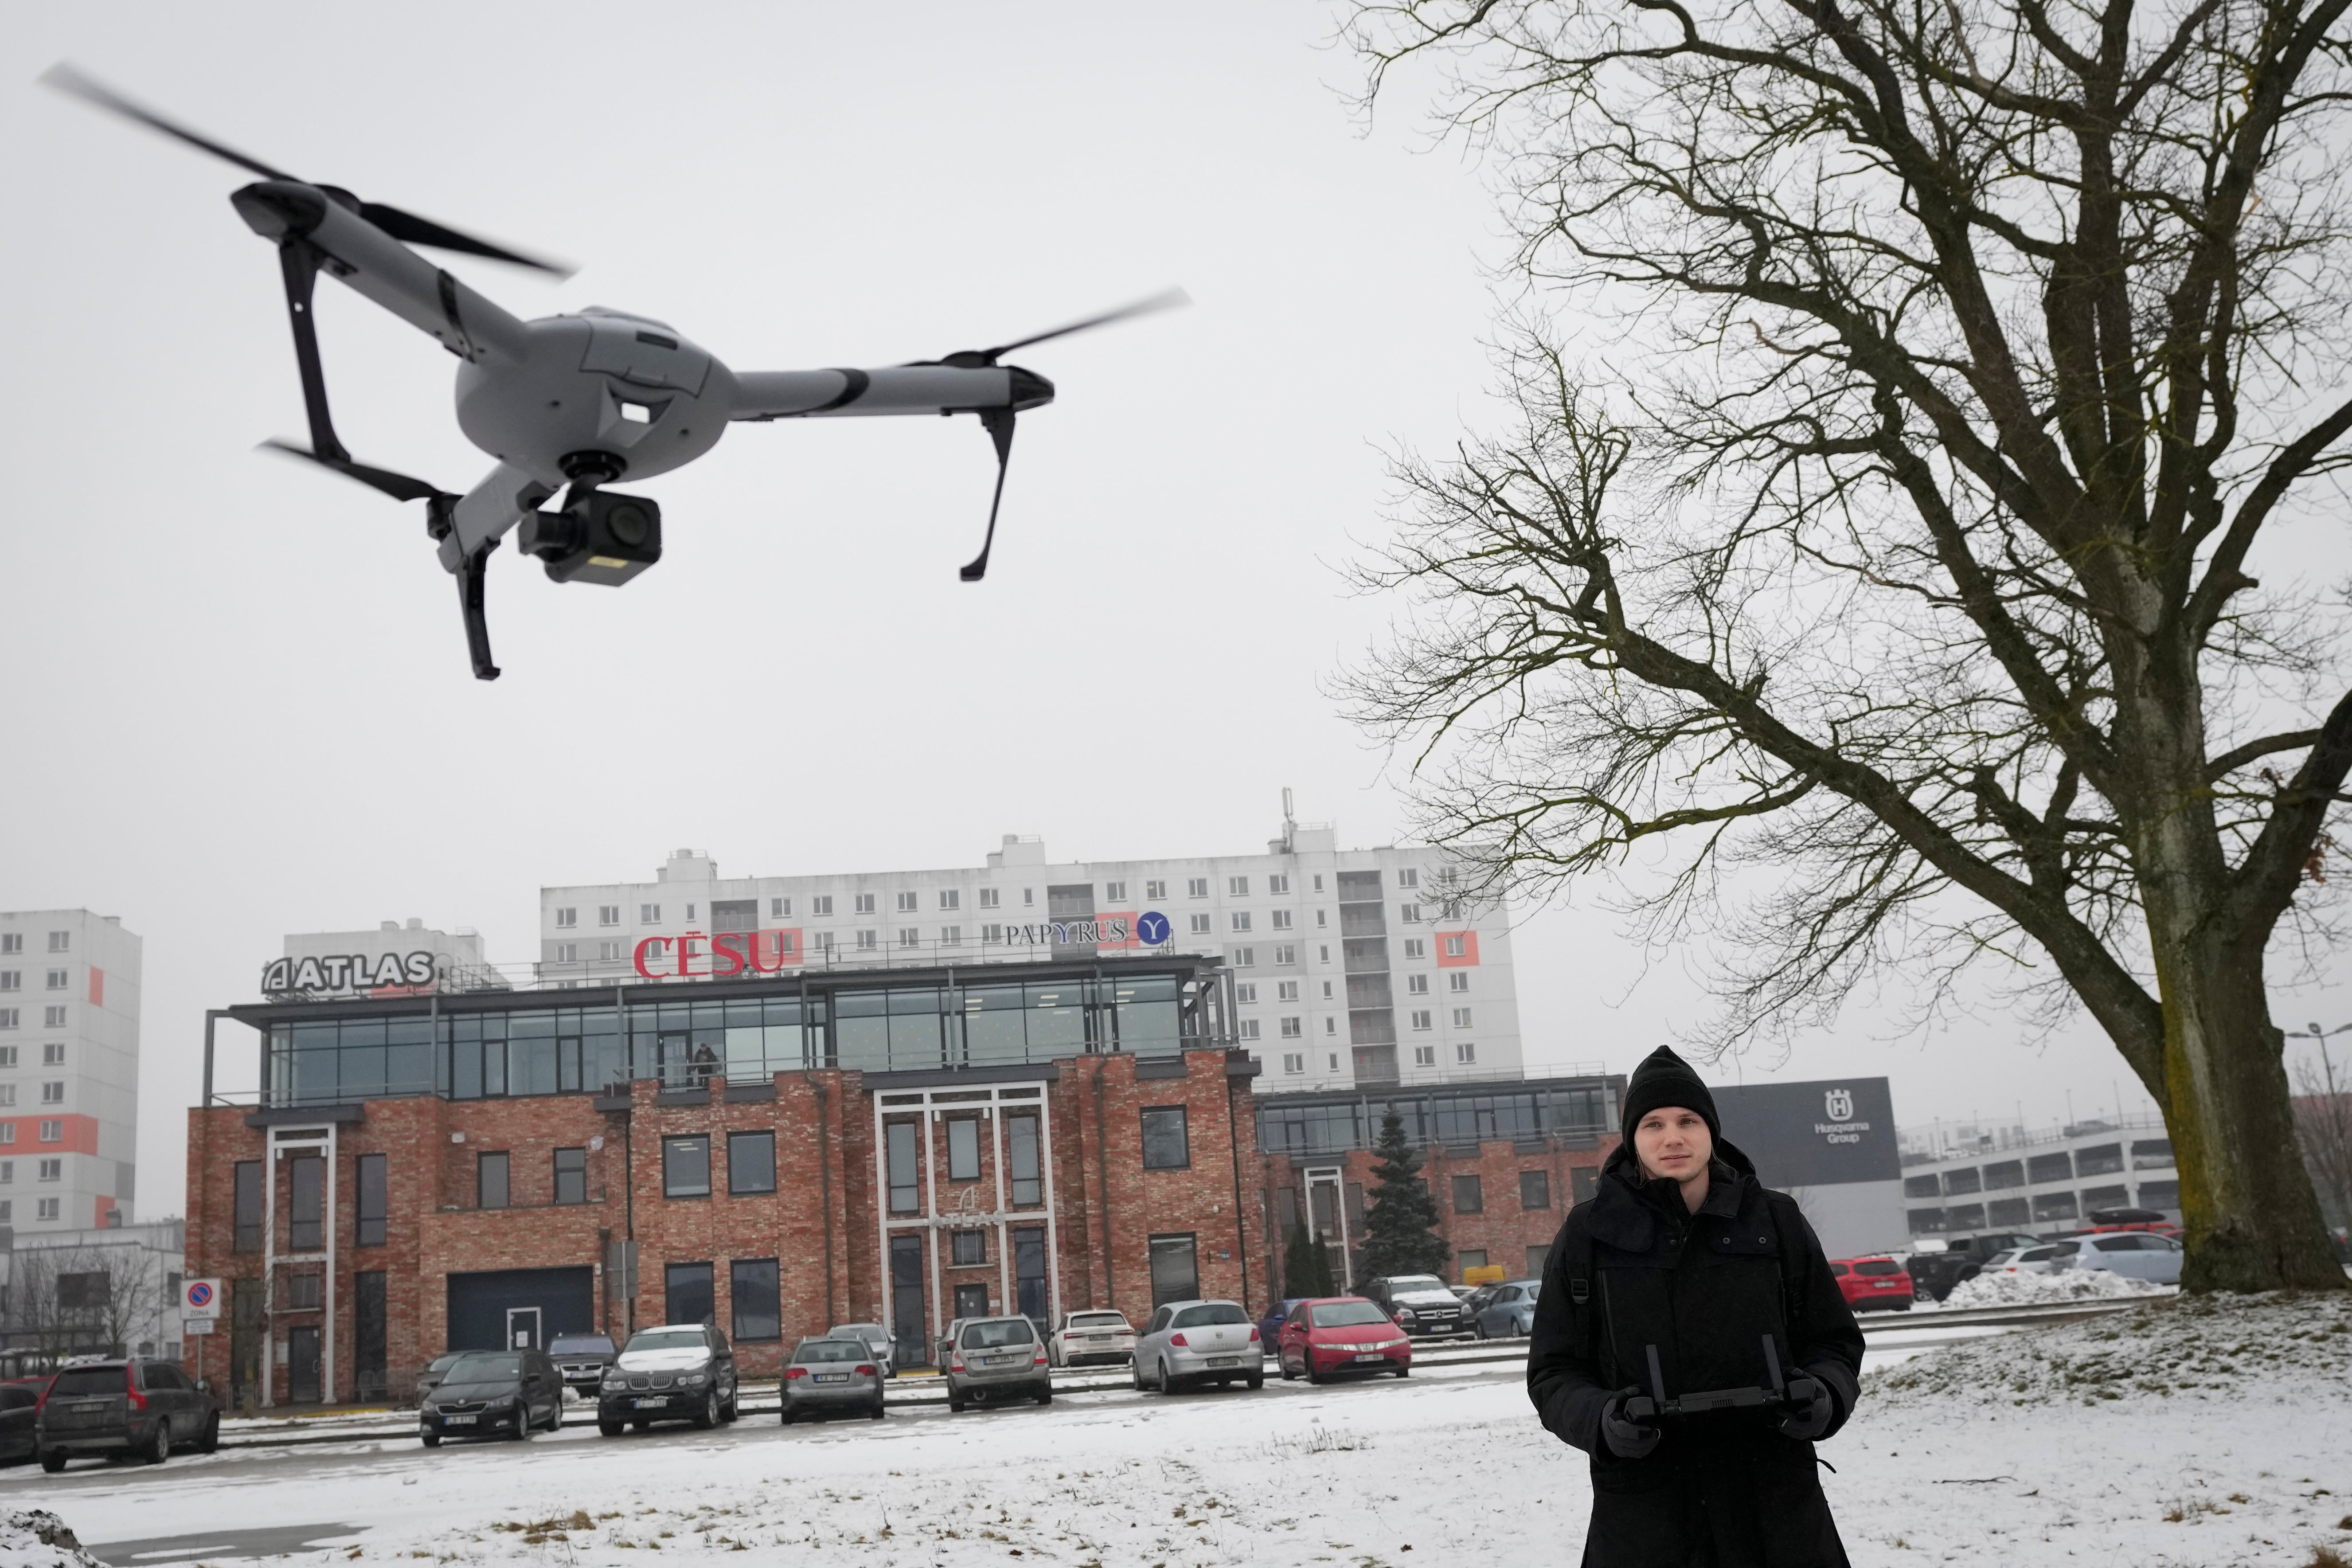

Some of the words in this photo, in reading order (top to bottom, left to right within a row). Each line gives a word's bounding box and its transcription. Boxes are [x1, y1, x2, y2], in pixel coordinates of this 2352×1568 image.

[1005, 919, 1127, 947] PAPYRUS
[633, 931, 784, 979] CĒSU
[293, 951, 434, 989] ATLAS
[1814, 1122, 1870, 1134] Husqvarna
[1827, 1133, 1860, 1144] Group
[930, 1210, 1005, 1230] ATLAS
